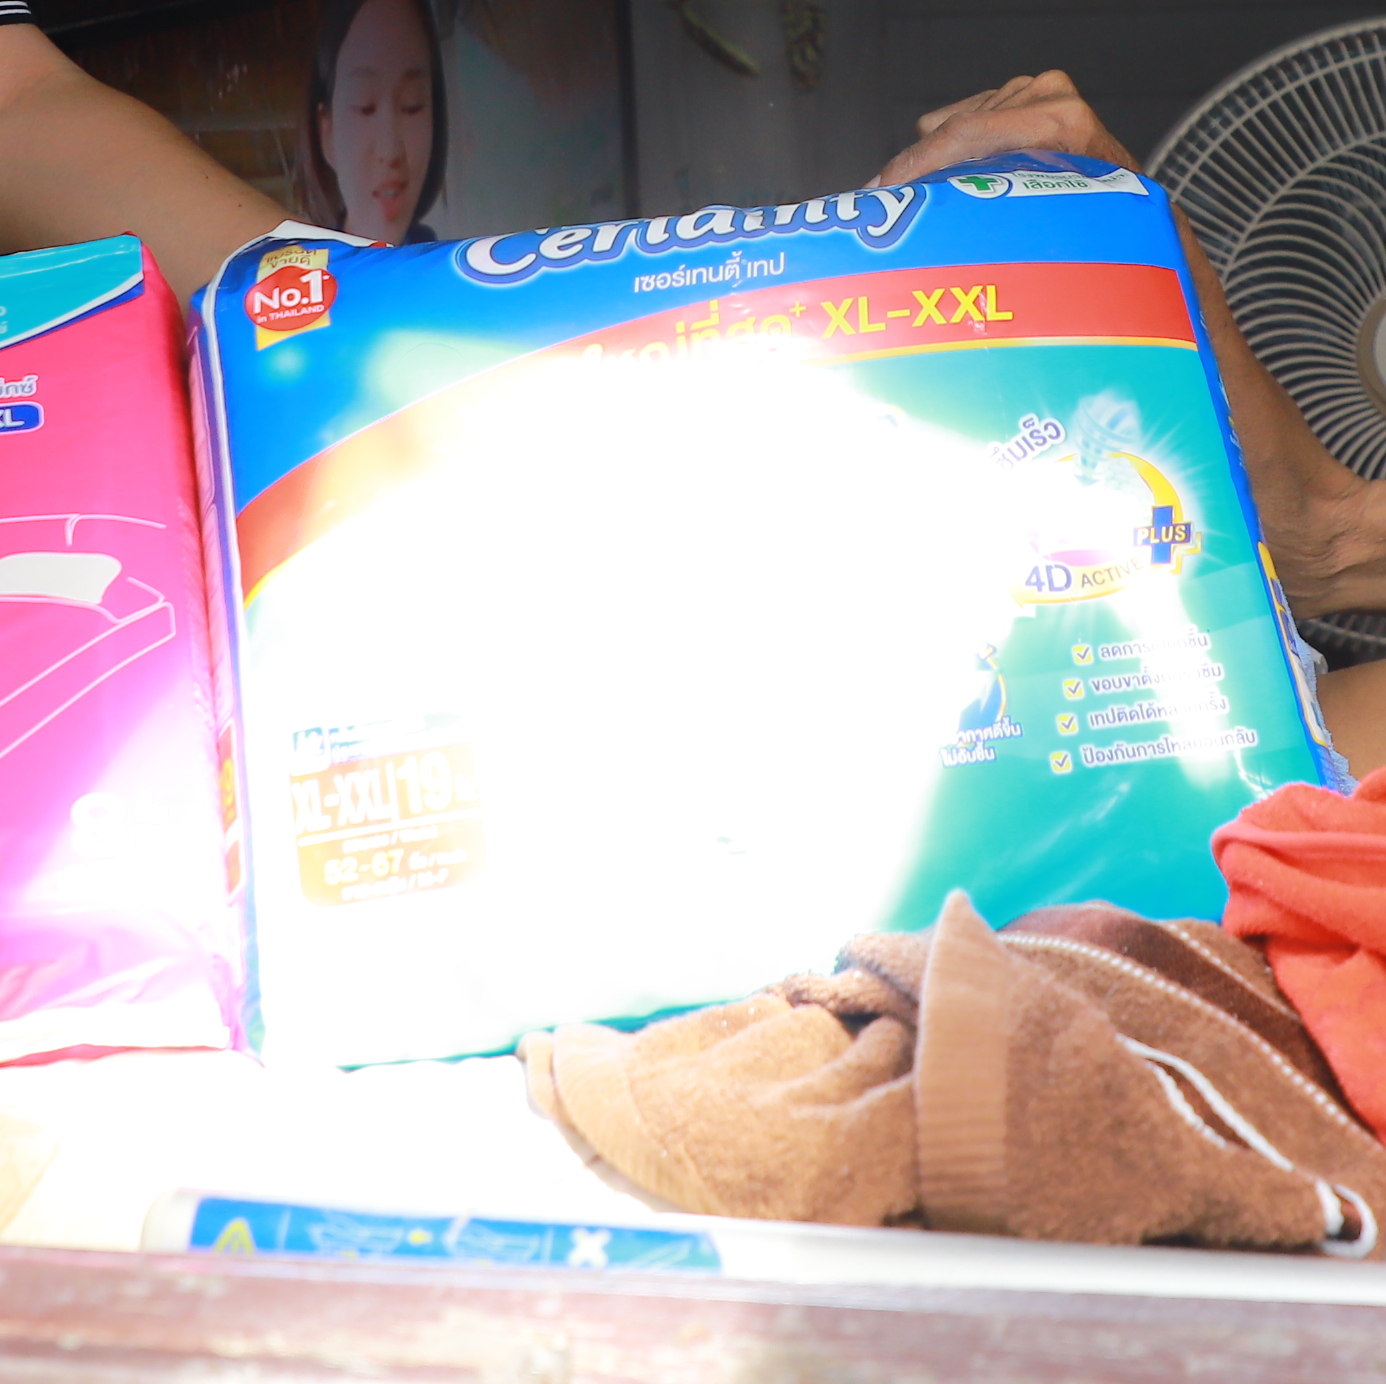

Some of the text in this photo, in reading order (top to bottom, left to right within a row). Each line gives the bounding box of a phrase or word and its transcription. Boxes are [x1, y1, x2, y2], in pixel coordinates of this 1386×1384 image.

[635, 251, 785, 293] เซอร์เทนตี้ เทป
[269, 304, 325, 320] THAILAND
[822, 285, 1014, 339] XL-XXL
[1135, 524, 1186, 544] PLUS
[1025, 556, 1144, 593] 4D ACTIVE
